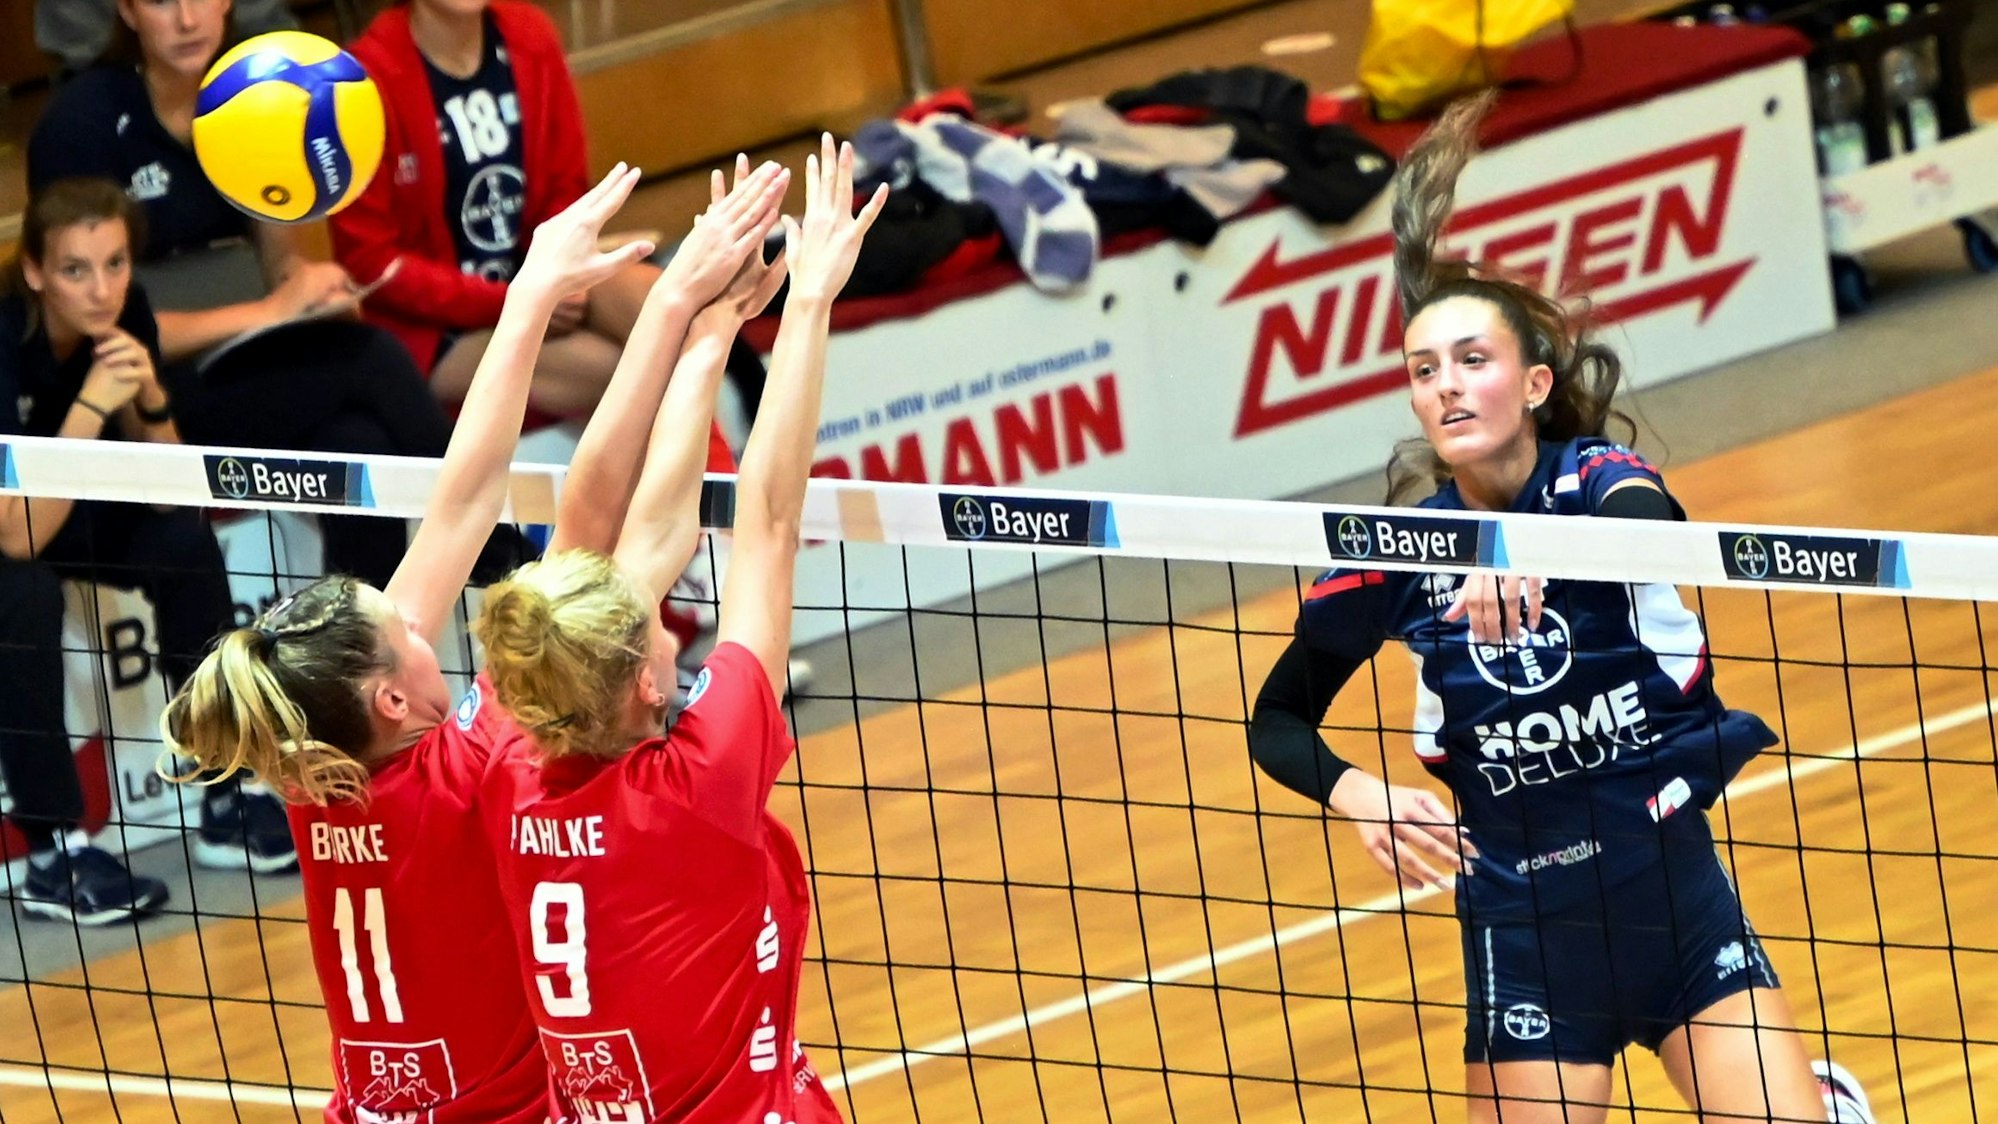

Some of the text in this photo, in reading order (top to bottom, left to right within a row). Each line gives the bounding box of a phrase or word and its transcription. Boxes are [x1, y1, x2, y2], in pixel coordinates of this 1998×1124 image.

[444, 88, 510, 164] 18
[1250, 185, 1728, 380] NISEN
[932, 382, 963, 410] und
[252, 462, 328, 502] Bayer
[990, 502, 1070, 543] Bayer
[1375, 521, 1457, 562] Bayer
[1773, 541, 1857, 582] Bayer
[1474, 681, 1647, 759] HOME
[1477, 721, 1663, 796] DELUXE
[511, 815, 605, 857] AHLKE
[333, 887, 404, 1022] 11
[530, 881, 591, 1017] 9
[369, 1050, 421, 1088] BTS
[561, 1040, 613, 1075] BTS
